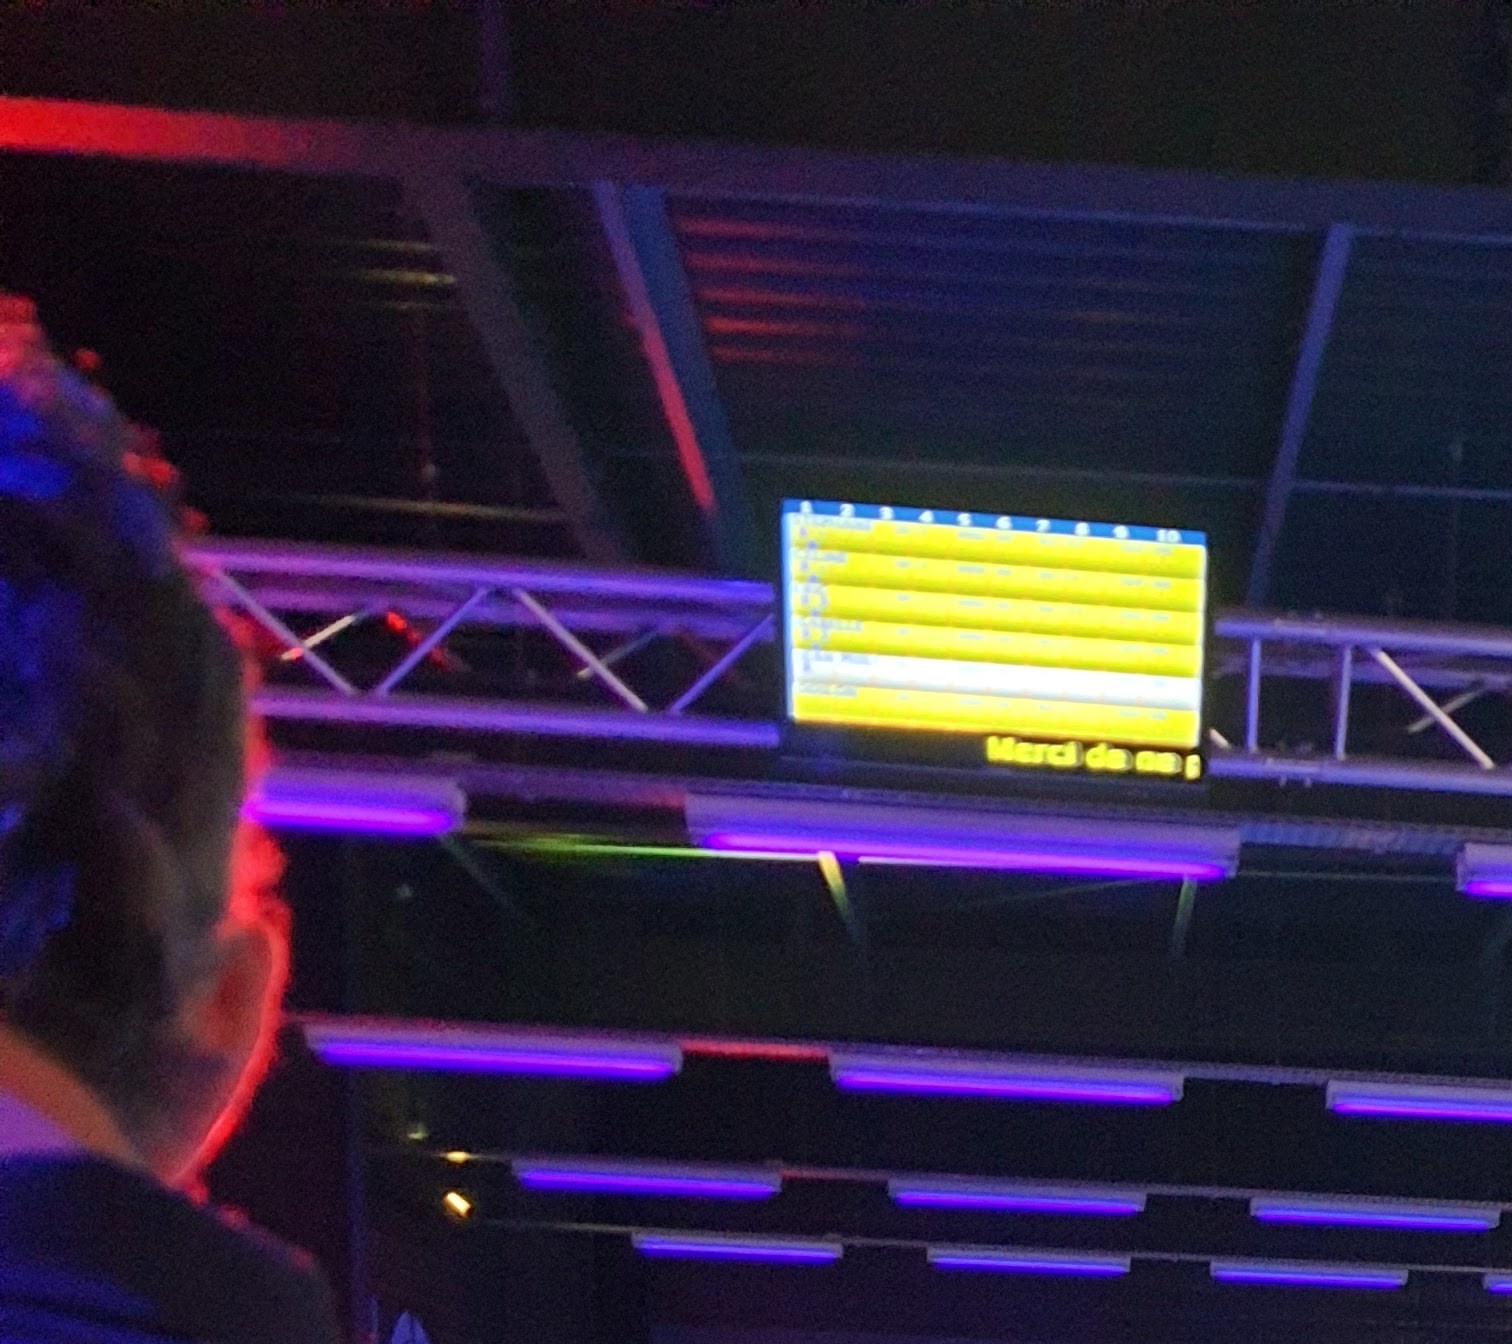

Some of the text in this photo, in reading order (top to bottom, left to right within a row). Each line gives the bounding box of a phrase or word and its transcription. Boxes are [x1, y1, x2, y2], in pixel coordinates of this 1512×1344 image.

[840, 504, 854, 517] 2
[919, 510, 933, 523] 4
[995, 516, 1012, 530] 6
[1156, 529, 1181, 543] 10
[1085, 742, 1134, 771] de
